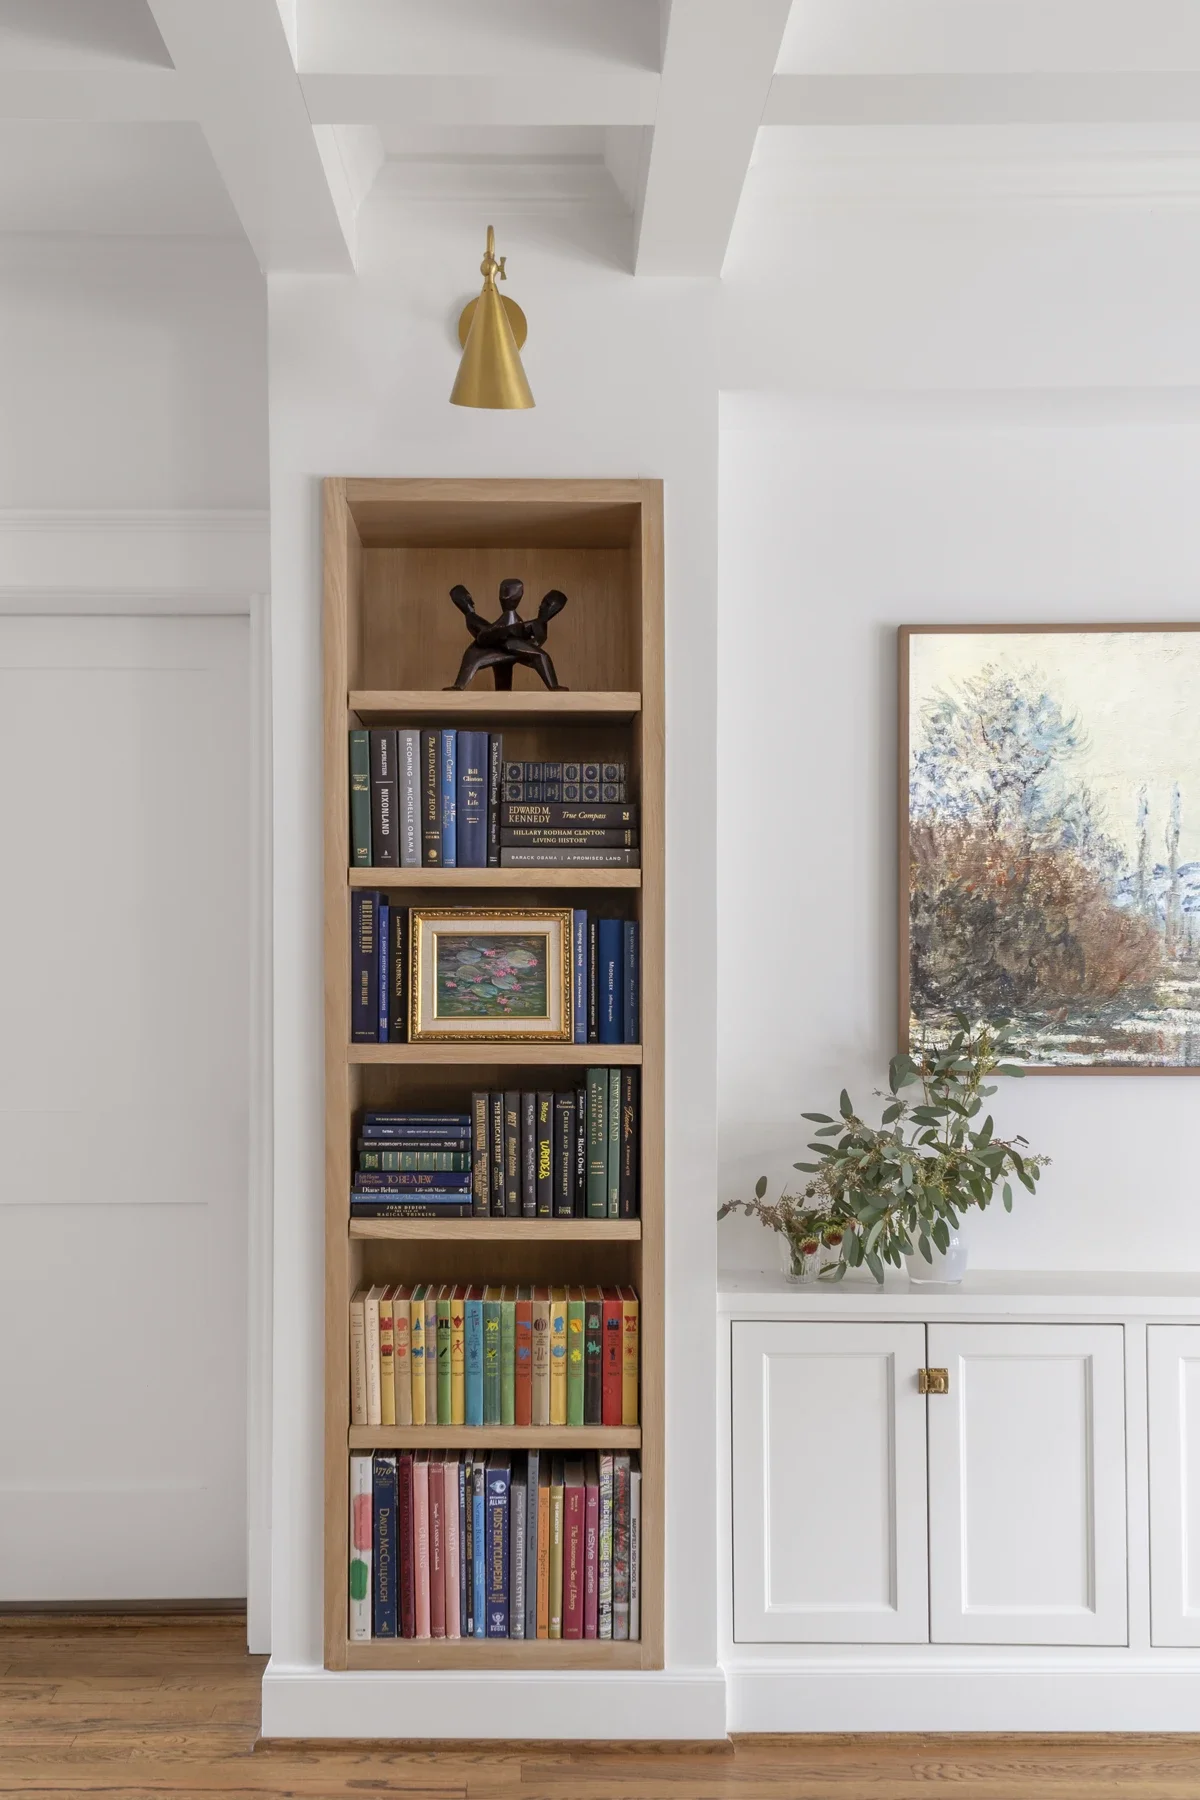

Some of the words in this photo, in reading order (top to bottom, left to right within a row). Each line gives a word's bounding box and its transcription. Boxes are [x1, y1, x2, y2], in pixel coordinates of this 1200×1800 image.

[444, 734, 454, 758] Jimmy
[381, 788, 390, 835] NIXONLAND
[509, 806, 540, 814] EDWARD
[542, 806, 550, 814] M.
[578, 812, 606, 821] Compass
[362, 900, 372, 934] AMERICAN
[476, 1100, 485, 1123] PATRICIA
[508, 1111, 516, 1127] PREY
[476, 1123, 485, 1150] CORNWELL
[598, 1132, 602, 1141] OF
[539, 1140, 550, 1179] WONDER
[386, 1175, 398, 1183] TO
[399, 1175, 409, 1183] BE
[410, 1175, 418, 1183] A
[418, 1175, 433, 1183] JEW
[376, 1467, 392, 1476] 1776
[379, 1507, 390, 1535] DAVID
[419, 1527, 428, 1568] GRILLING
[493, 1530, 503, 1590] ENCYCLOPEDIA
[539, 1549, 548, 1577] Paperie
[569, 1589, 577, 1610] Liberty
